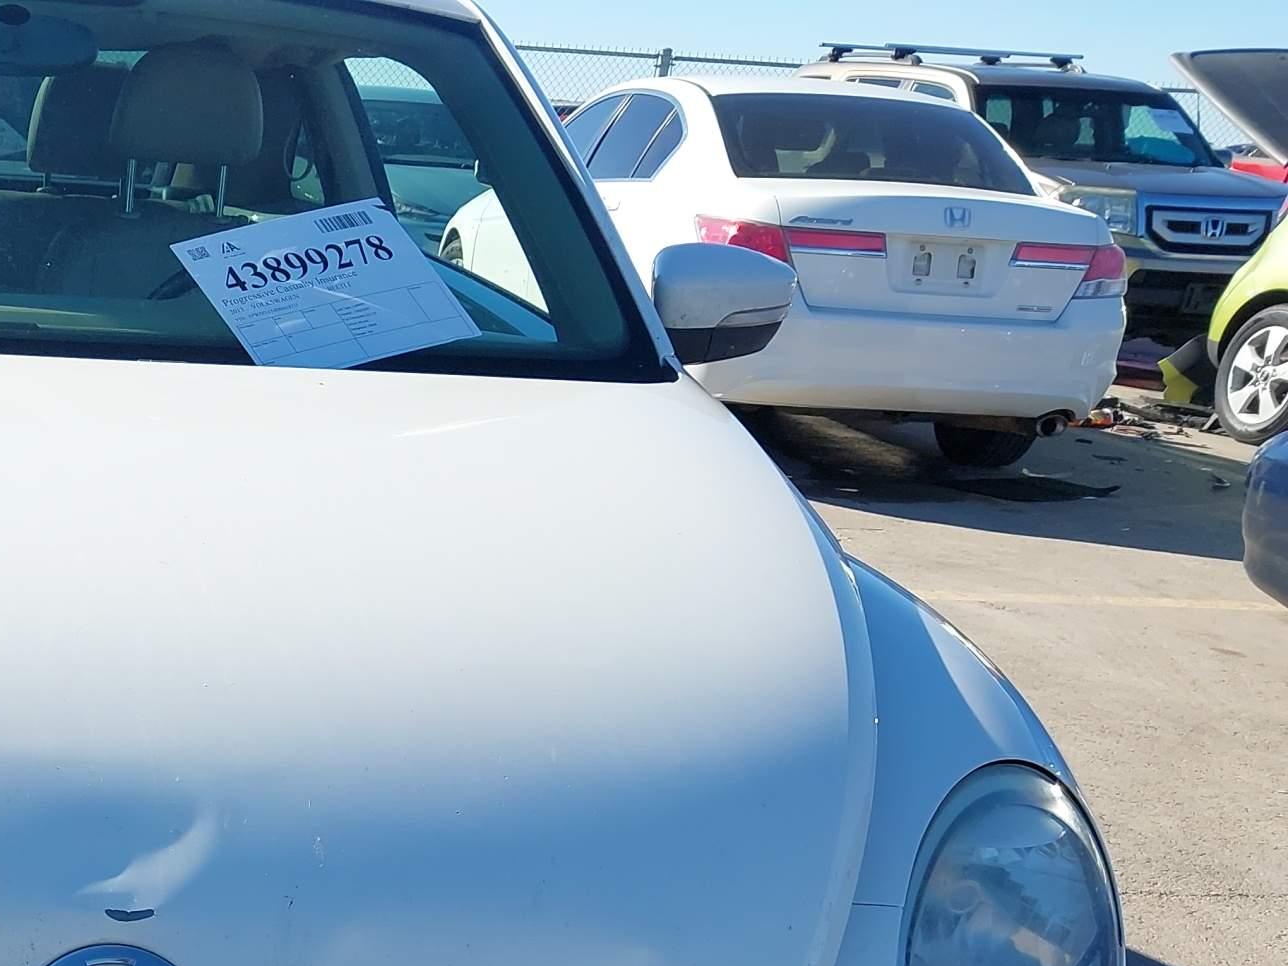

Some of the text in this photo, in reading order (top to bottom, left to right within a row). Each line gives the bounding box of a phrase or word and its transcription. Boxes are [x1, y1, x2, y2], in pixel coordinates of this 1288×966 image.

[225, 235, 393, 291] 43899278
[221, 270, 358, 308] Progressive Casualty Insurance
